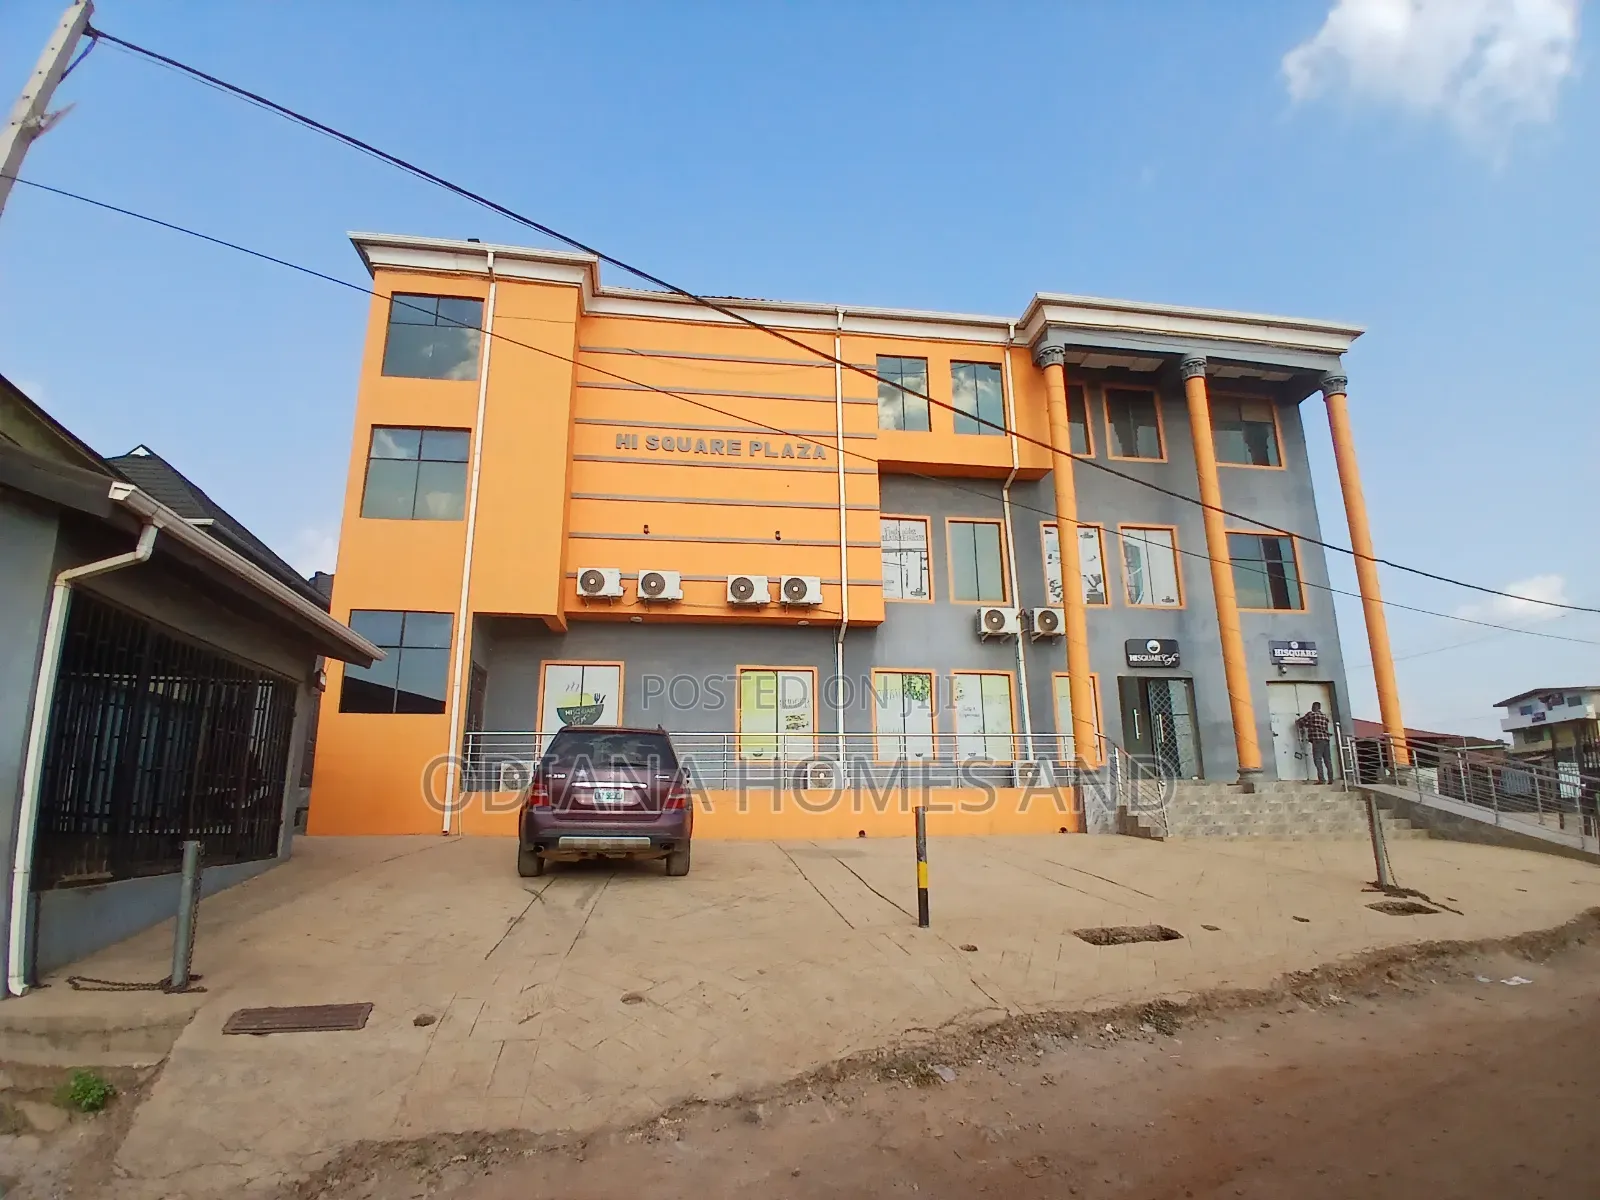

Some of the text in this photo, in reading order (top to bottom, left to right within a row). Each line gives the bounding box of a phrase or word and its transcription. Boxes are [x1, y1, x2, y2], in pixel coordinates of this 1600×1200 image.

[616, 433, 827, 460] HI SQUARE PLAZA
